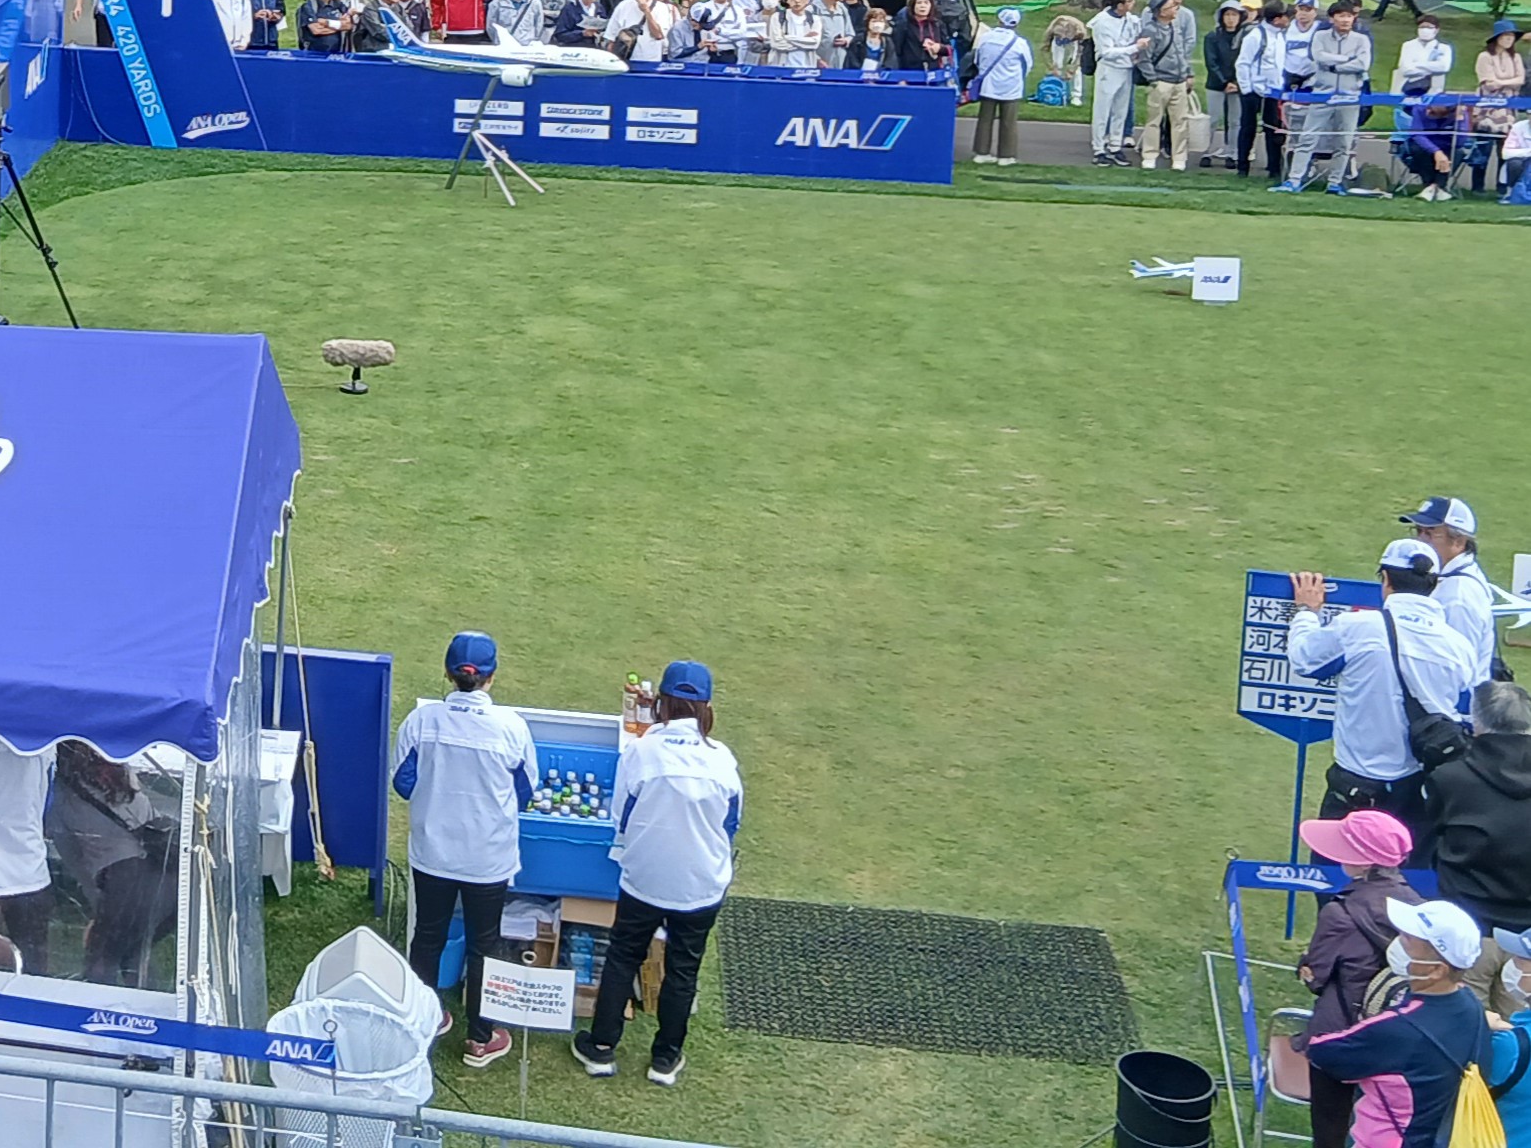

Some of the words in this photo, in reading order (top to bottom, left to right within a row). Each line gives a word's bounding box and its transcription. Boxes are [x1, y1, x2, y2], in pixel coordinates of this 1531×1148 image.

[116, 25, 140, 56] 420
[127, 57, 161, 118] YARDS
[636, 128, 686, 141] ロキソニン
[774, 116, 861, 150] ANA
[1244, 658, 1290, 684] 石川
[86, 1011, 115, 1025] ANA
[118, 1015, 156, 1029] Open
[265, 1039, 313, 1061] ANA
